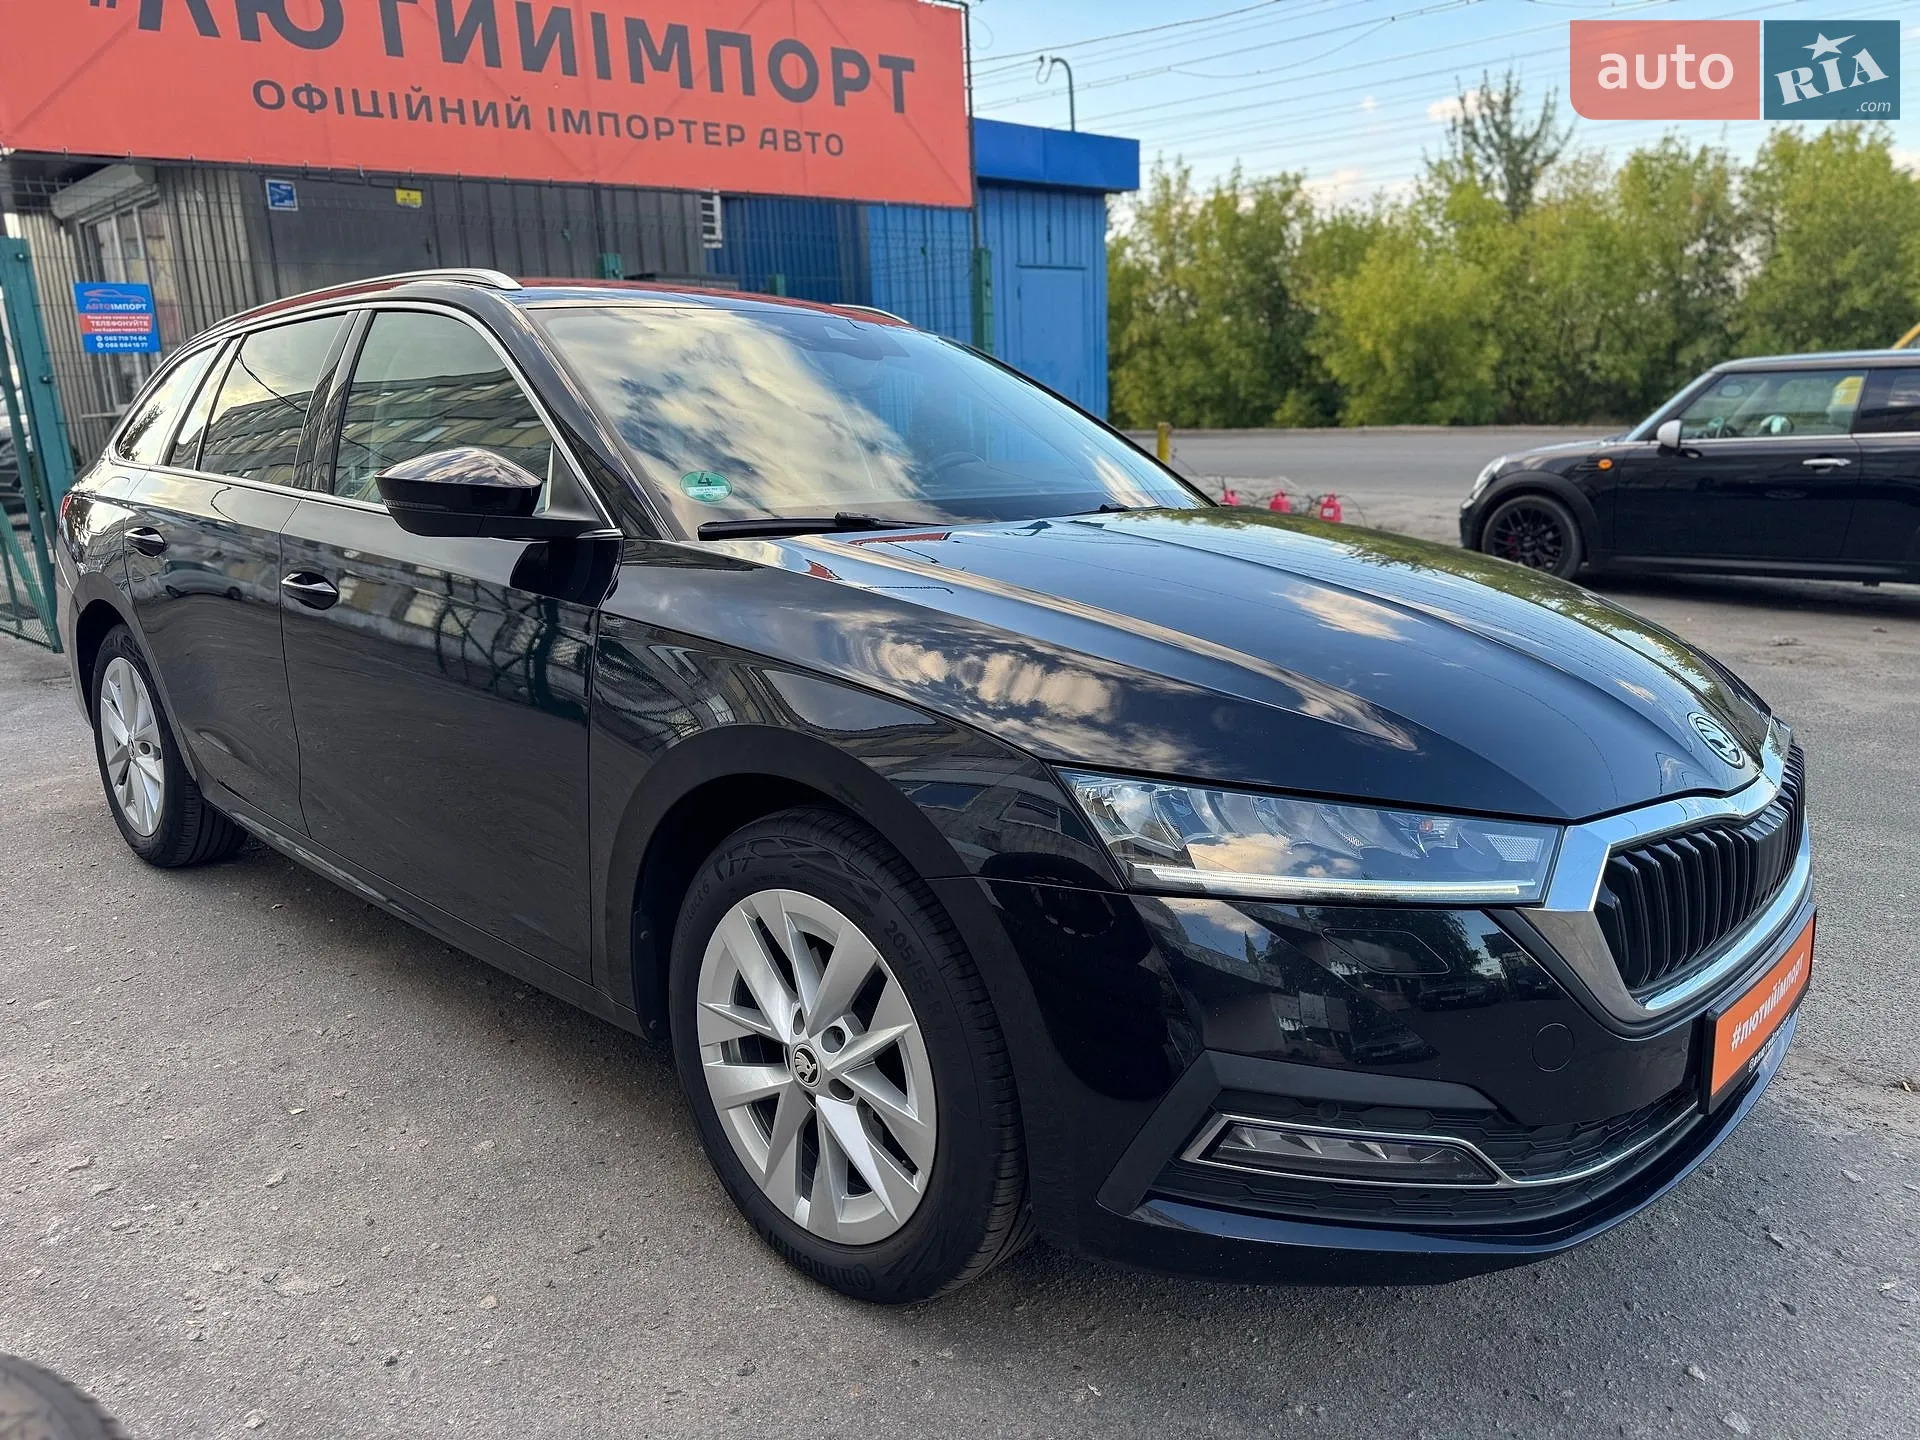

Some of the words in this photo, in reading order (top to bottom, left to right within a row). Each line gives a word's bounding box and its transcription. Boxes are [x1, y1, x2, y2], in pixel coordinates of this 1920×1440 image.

[252, 79, 531, 131] ОФІЦІЙНИЙ
[547, 106, 746, 147] ІМПОРТЕР
[759, 127, 844, 156] АВТО
